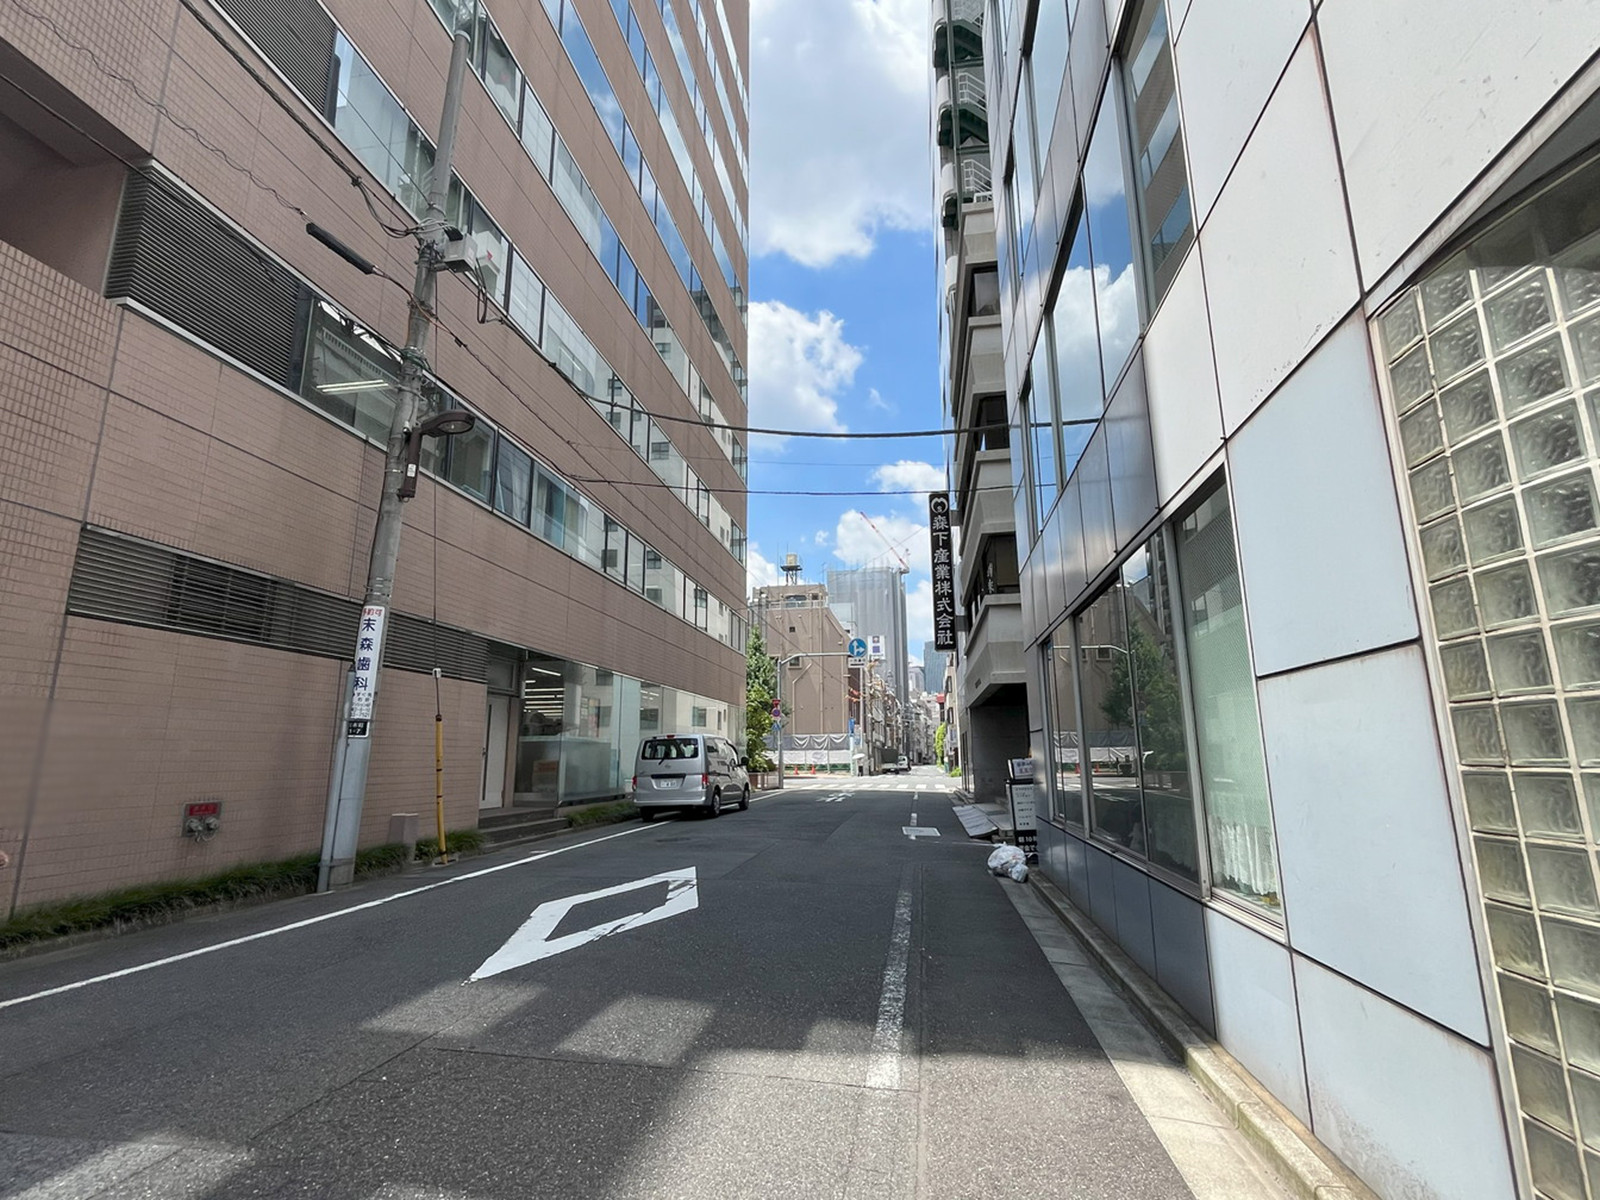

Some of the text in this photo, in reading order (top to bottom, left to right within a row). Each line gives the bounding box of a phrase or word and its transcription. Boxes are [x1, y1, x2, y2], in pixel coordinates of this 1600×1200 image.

[932, 515, 954, 645] 森下産業株式会社
[353, 617, 376, 691] 末森歯科
